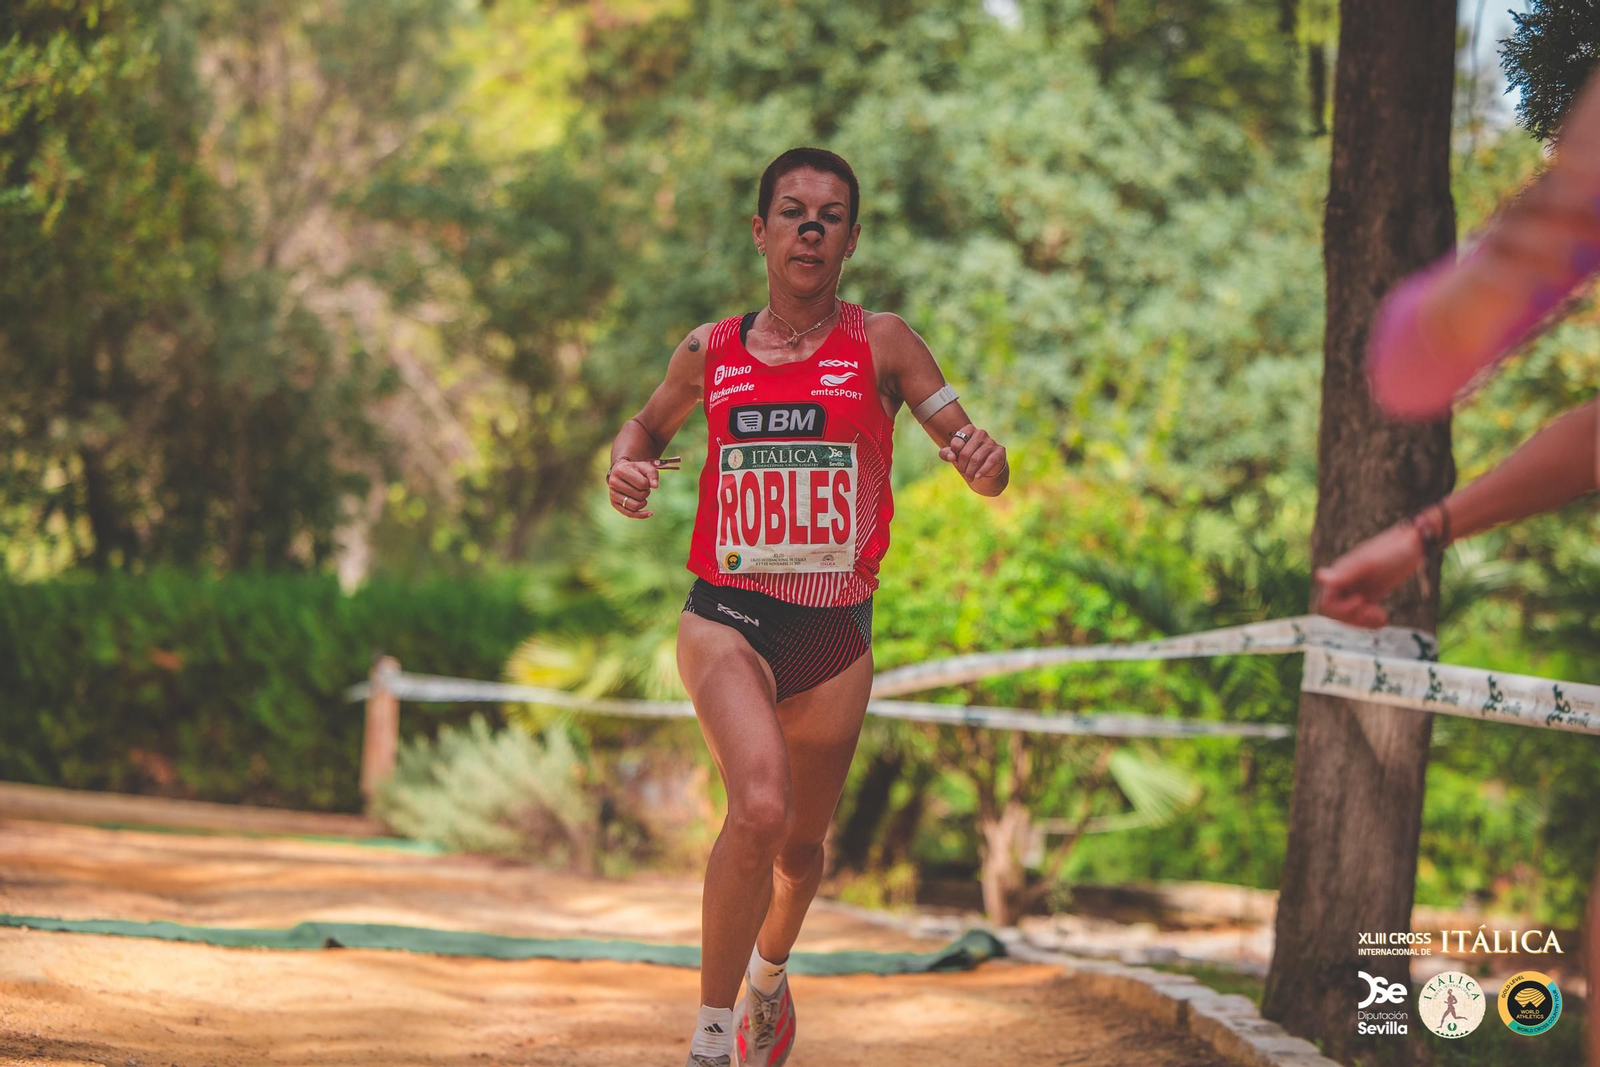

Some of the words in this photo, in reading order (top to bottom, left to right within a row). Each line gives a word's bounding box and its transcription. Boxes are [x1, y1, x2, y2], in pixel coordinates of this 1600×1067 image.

[714, 364, 752, 386] Bilbao
[811, 389, 863, 400] emteSPORT
[768, 409, 816, 432] BM
[752, 447, 818, 464] ITÁLICA
[719, 469, 851, 547] ROBLES
